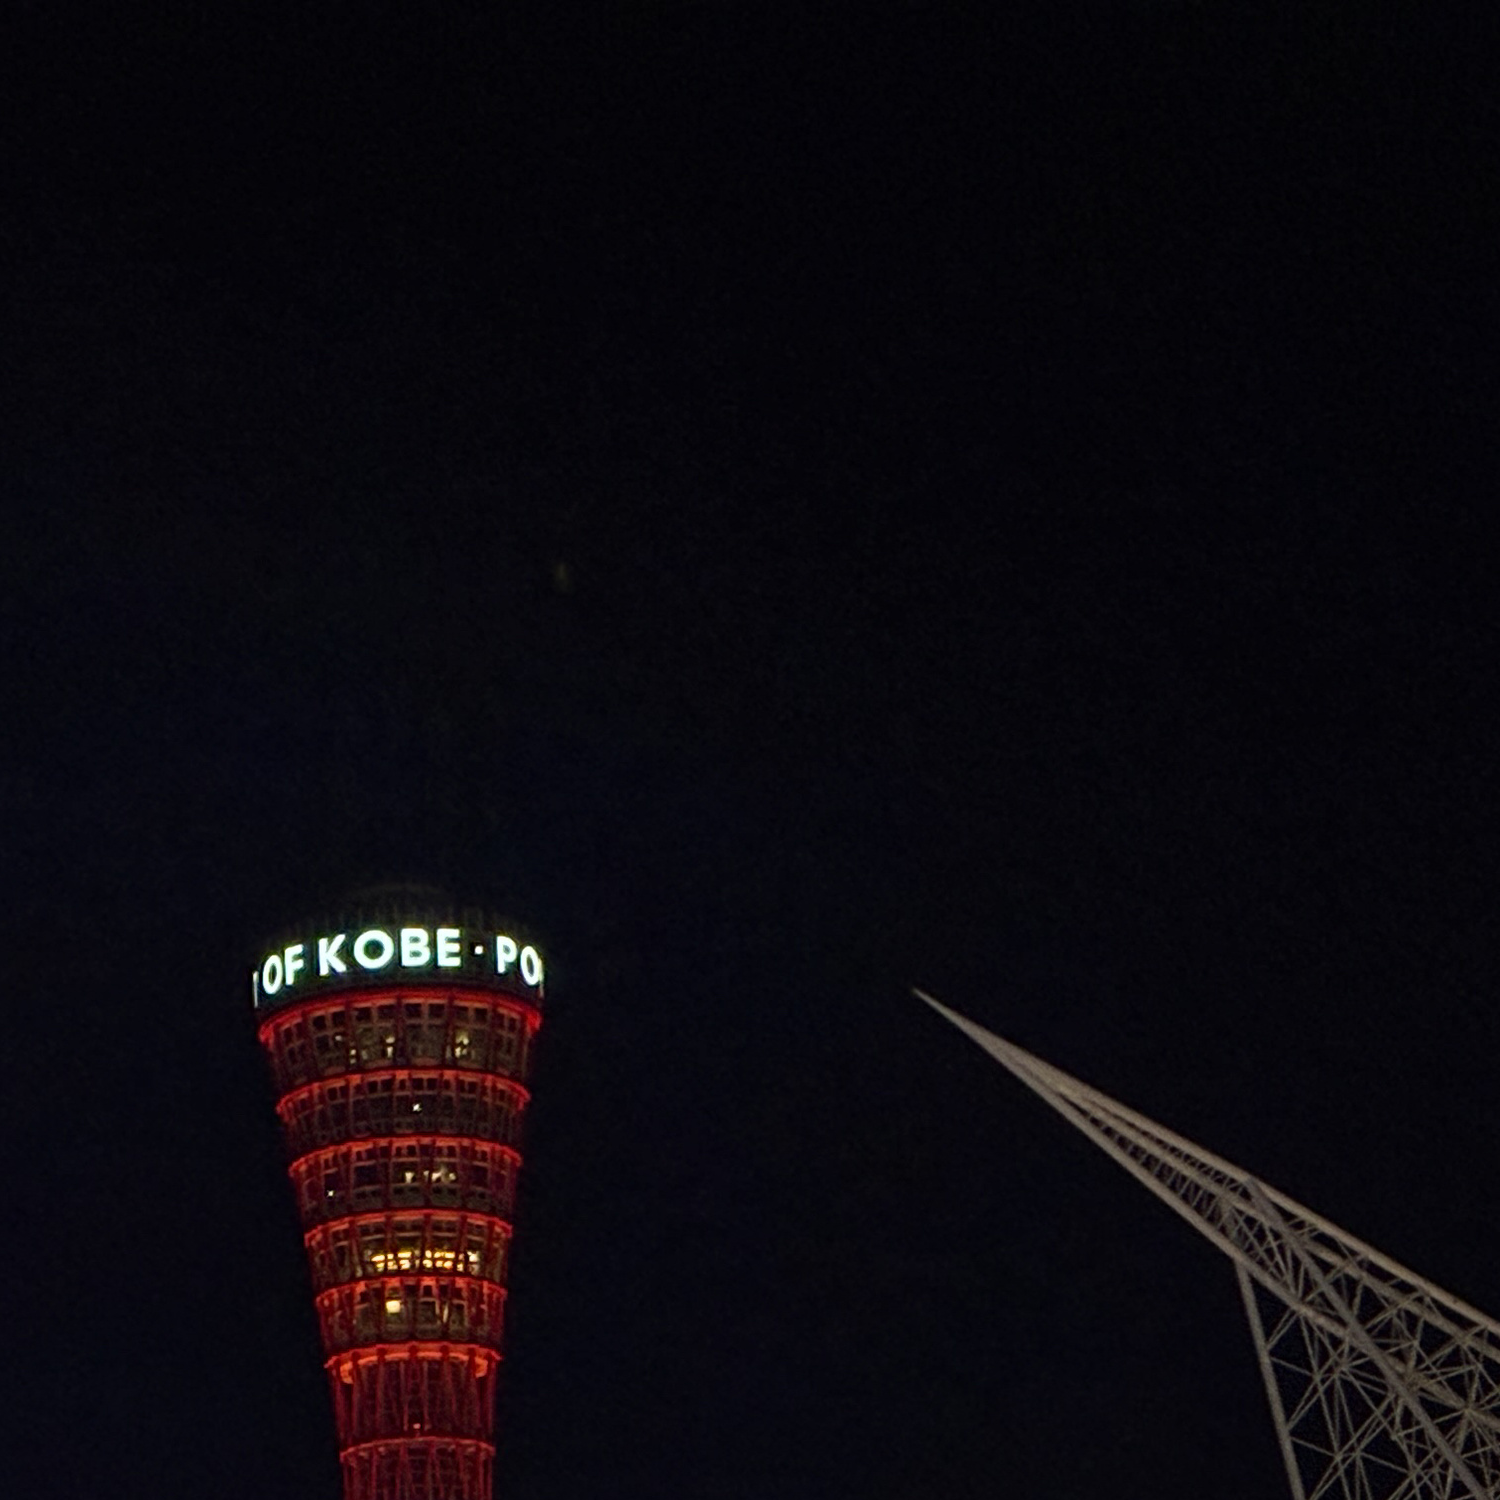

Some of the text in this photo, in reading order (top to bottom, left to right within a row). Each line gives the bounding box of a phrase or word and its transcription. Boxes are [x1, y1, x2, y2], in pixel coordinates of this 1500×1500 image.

[262, 944, 304, 995] OF
[318, 927, 461, 977] KOBE
[496, 935, 545, 995] PO
